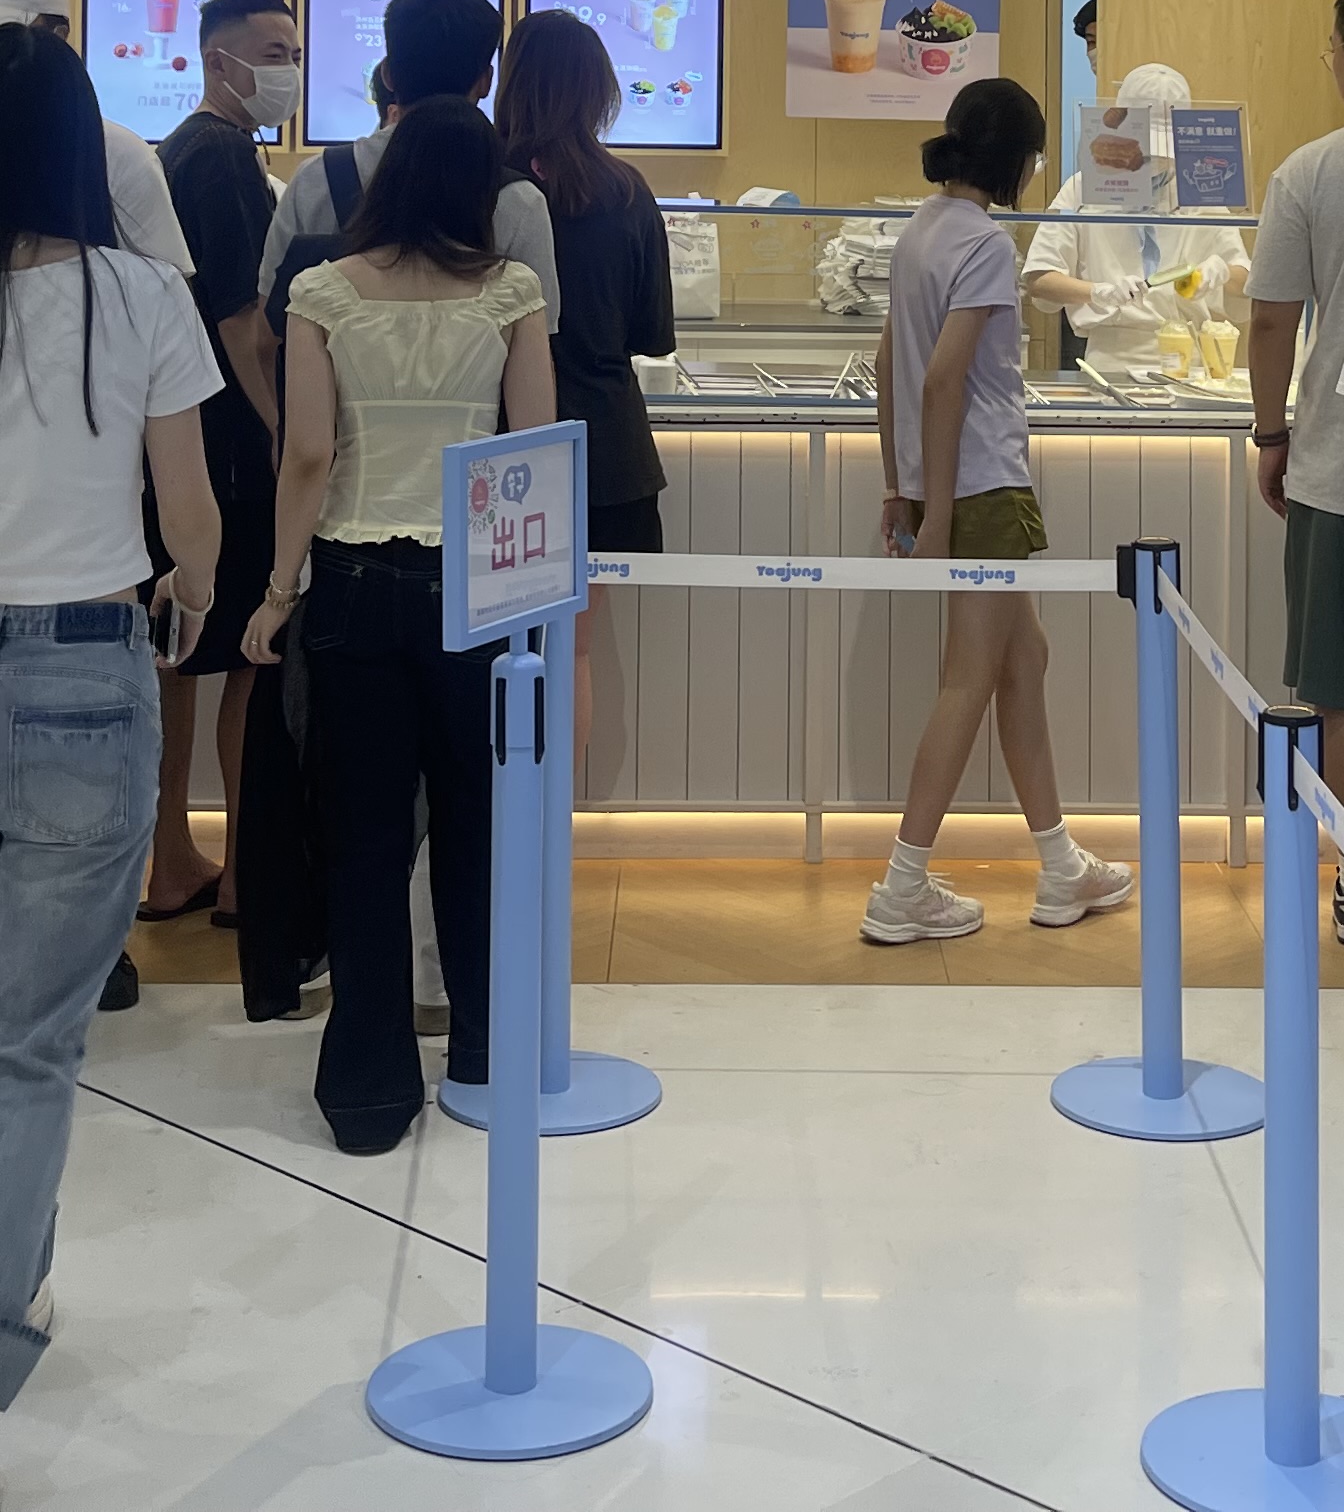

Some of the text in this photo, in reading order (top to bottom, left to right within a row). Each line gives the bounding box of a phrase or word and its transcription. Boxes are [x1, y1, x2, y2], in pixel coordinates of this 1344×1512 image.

[491, 511, 546, 571] 出口
[756, 562, 823, 582] Yoajung
[949, 565, 1016, 585] Yoajung
